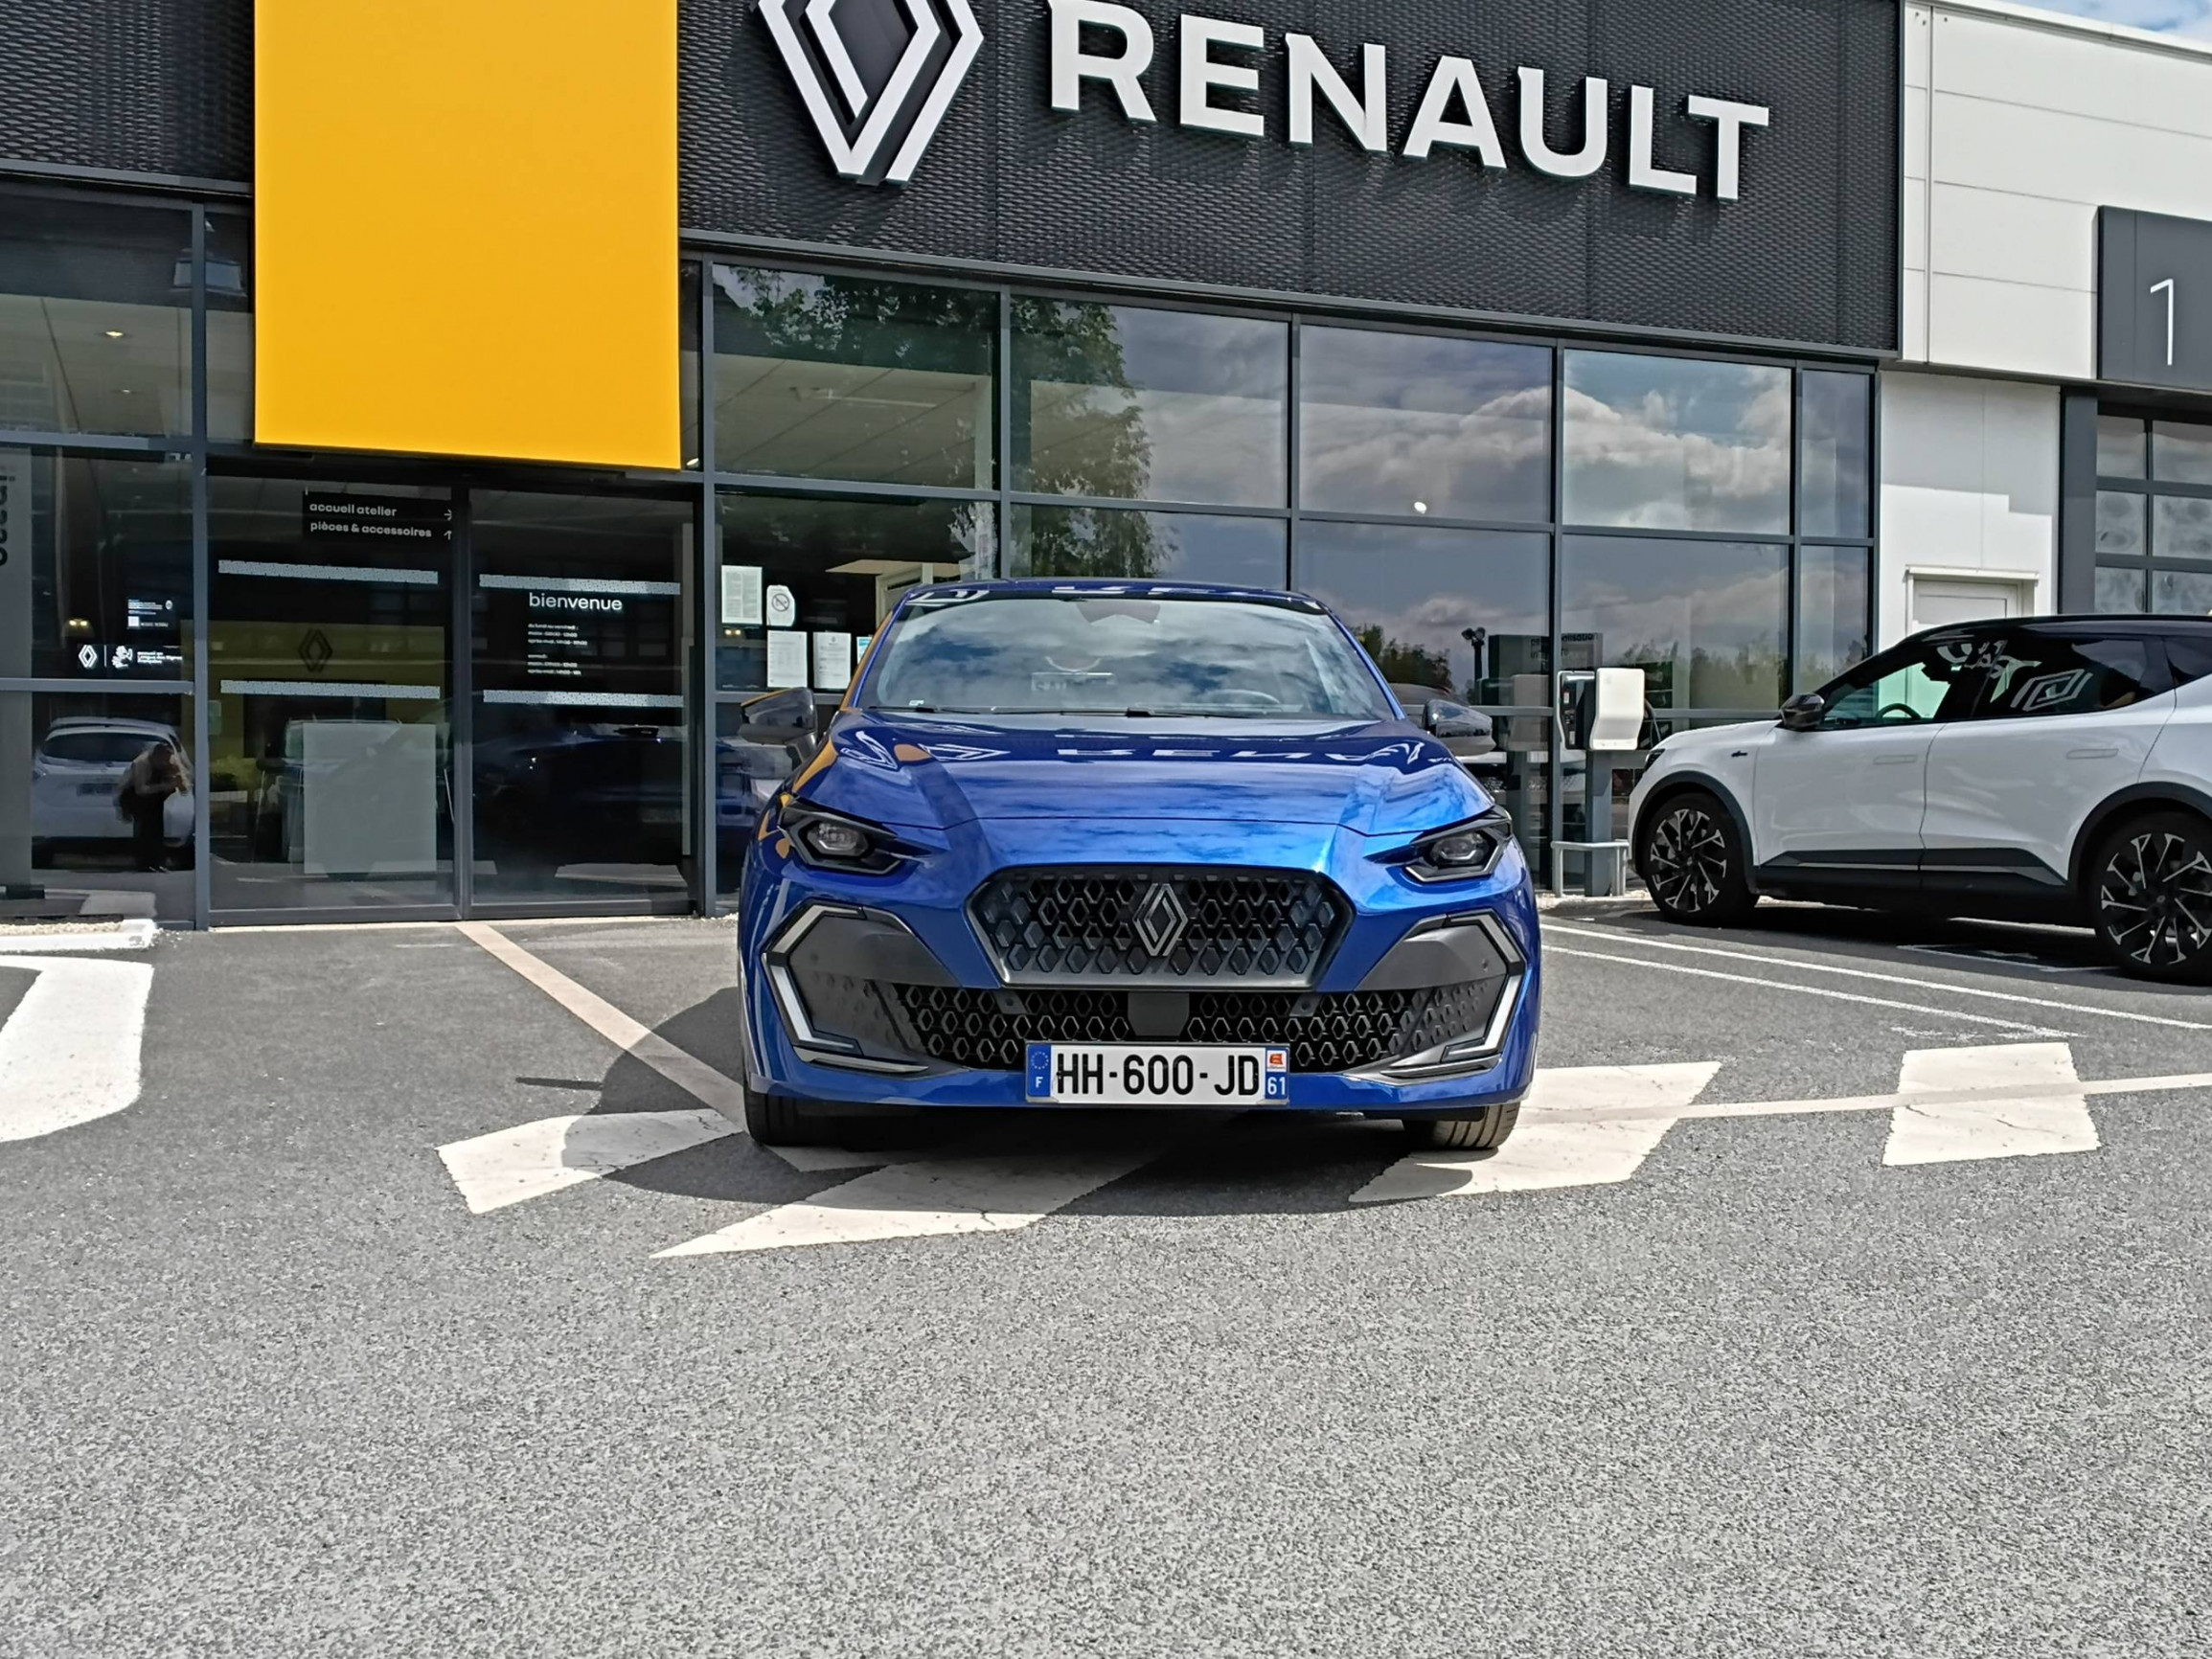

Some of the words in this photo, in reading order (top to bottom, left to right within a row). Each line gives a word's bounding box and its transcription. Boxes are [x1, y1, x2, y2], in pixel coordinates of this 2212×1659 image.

[1049, 0, 1769, 201] RENAULT
[2150, 278, 2176, 367] 1
[309, 502, 355, 514] accueil
[356, 505, 398, 517] atelier
[351, 524, 360, 534] &
[361, 526, 432, 538] accessoires
[529, 592, 623, 611] bienvenue
[1035, 1076, 1044, 1088] F
[1057, 1053, 1260, 1096] HH-600-JD
[1267, 1077, 1286, 1096] 61
